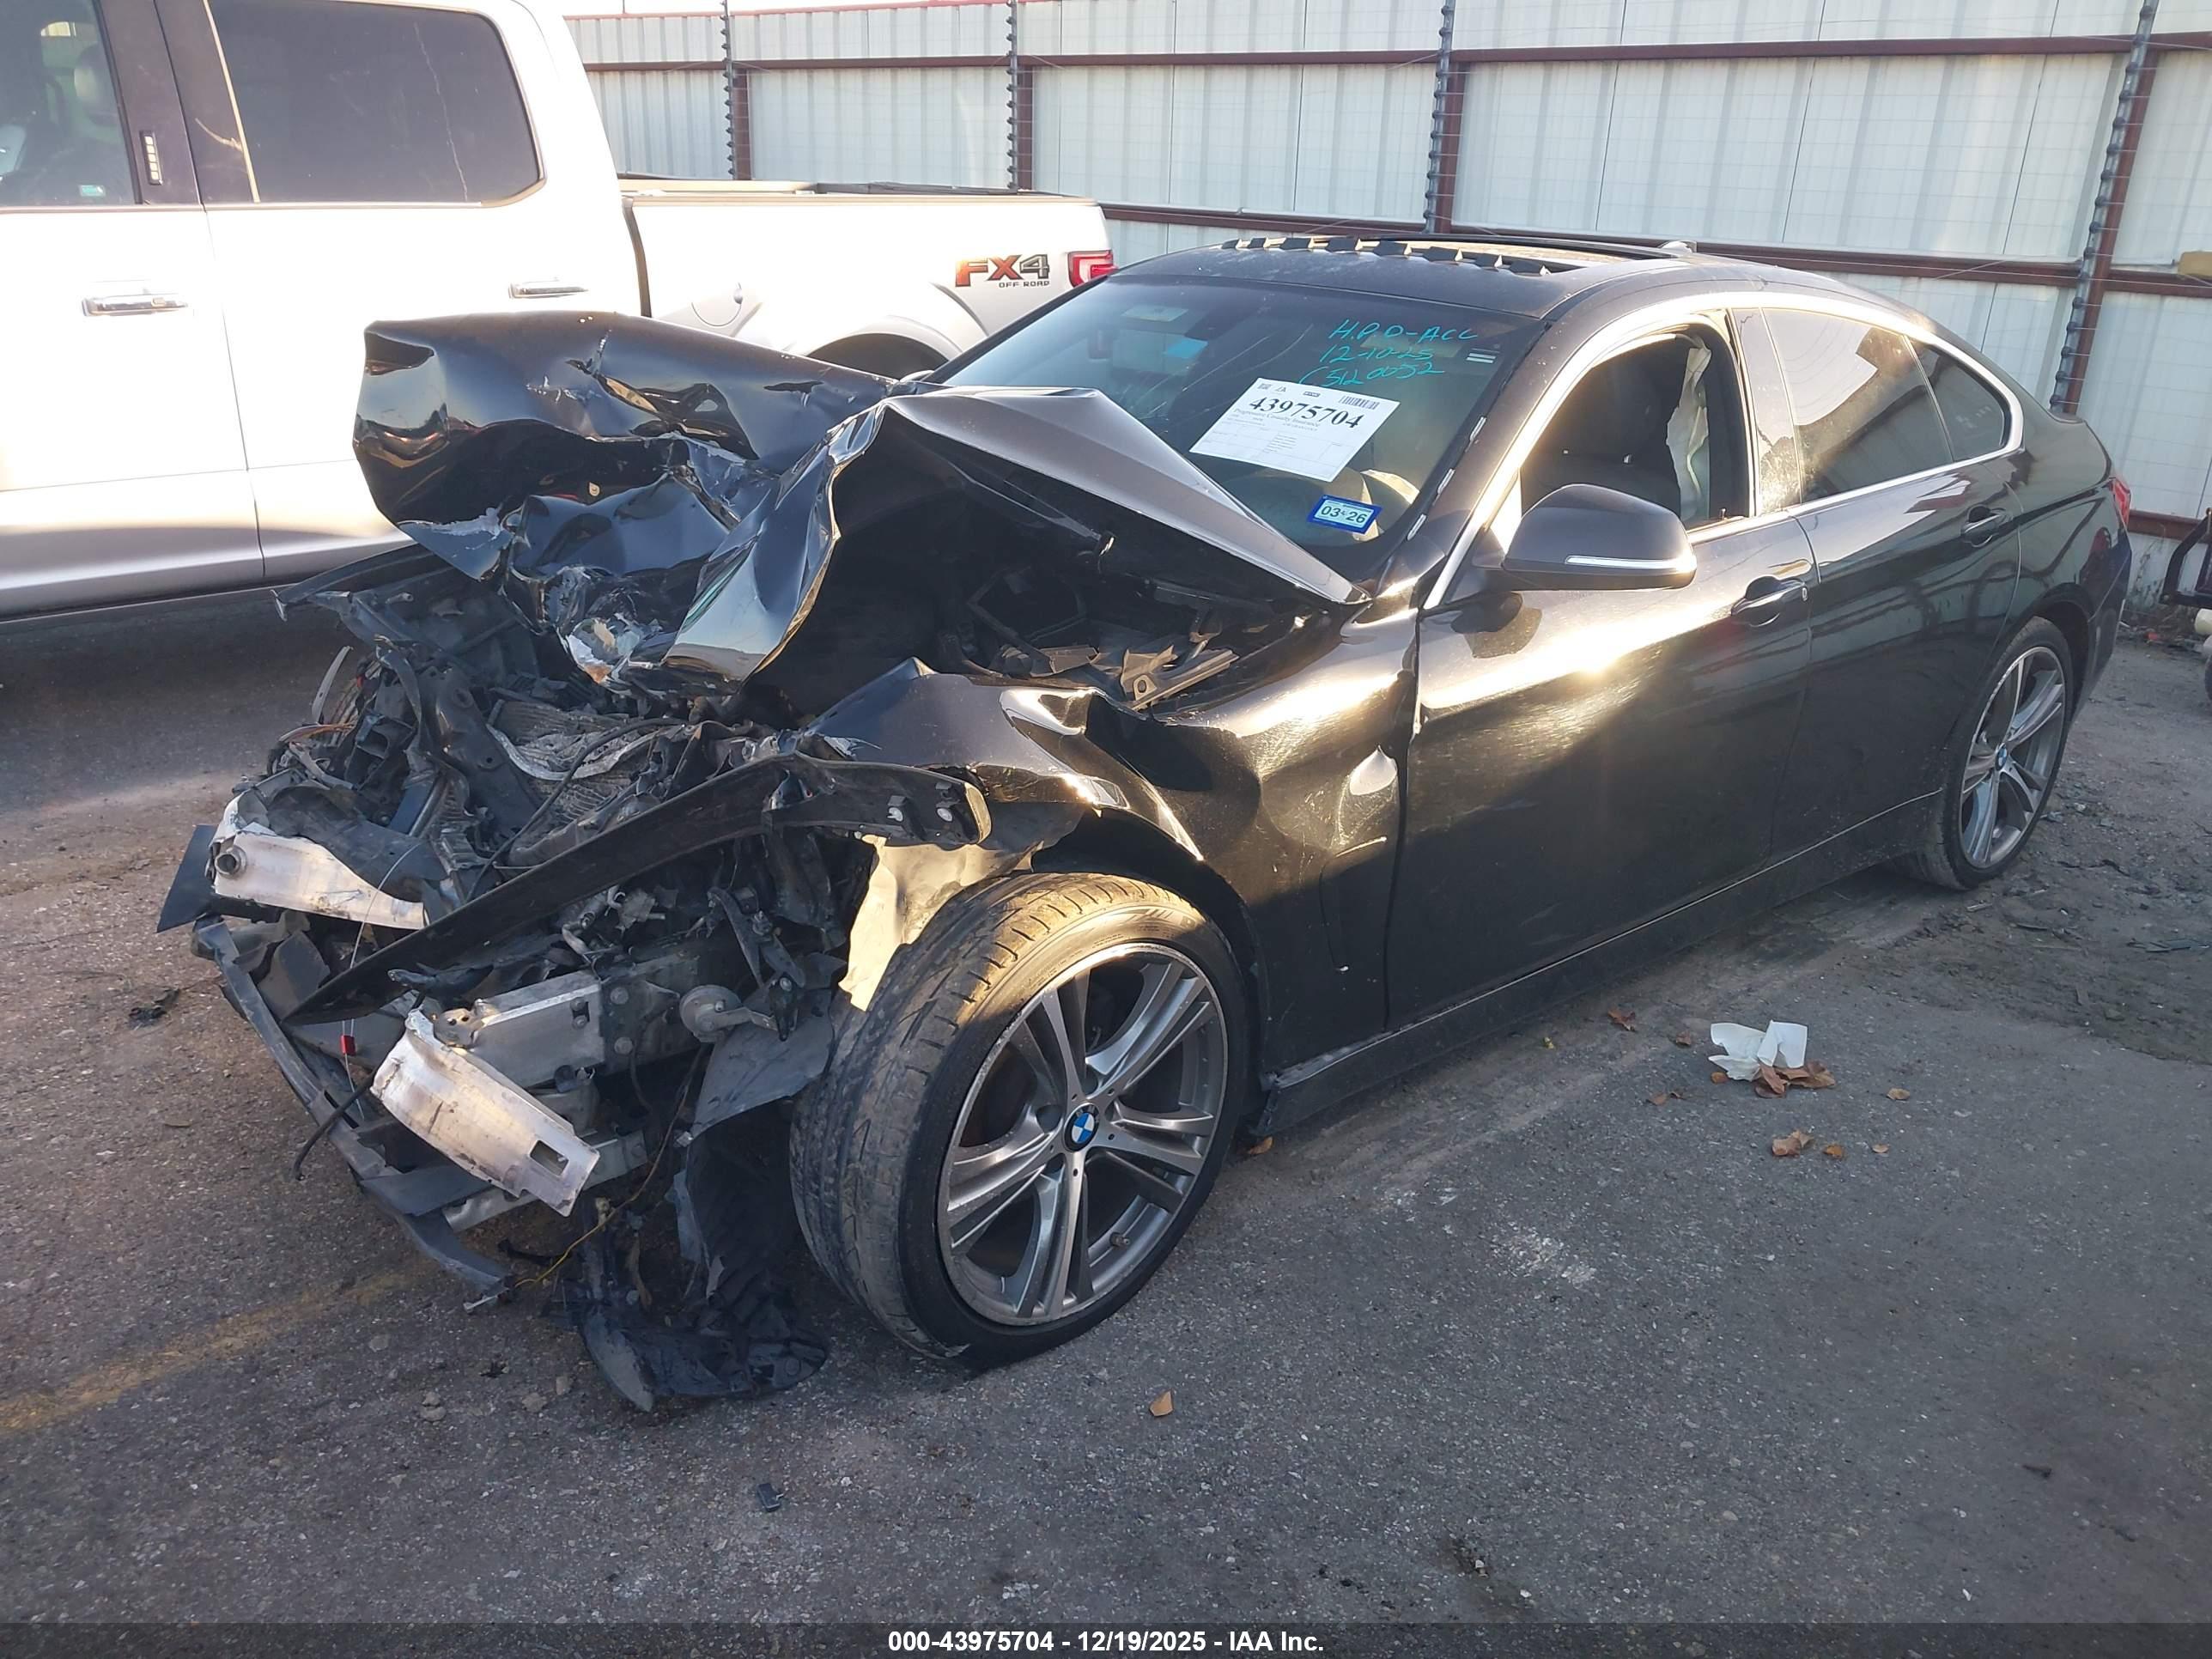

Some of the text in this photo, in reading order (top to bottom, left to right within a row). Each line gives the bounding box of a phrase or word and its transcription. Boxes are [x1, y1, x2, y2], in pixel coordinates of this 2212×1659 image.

[955, 254, 1050, 287] FX4
[1249, 397, 1364, 428] 43975704
[1321, 506, 1341, 518] 03
[1345, 511, 1368, 524] 26
